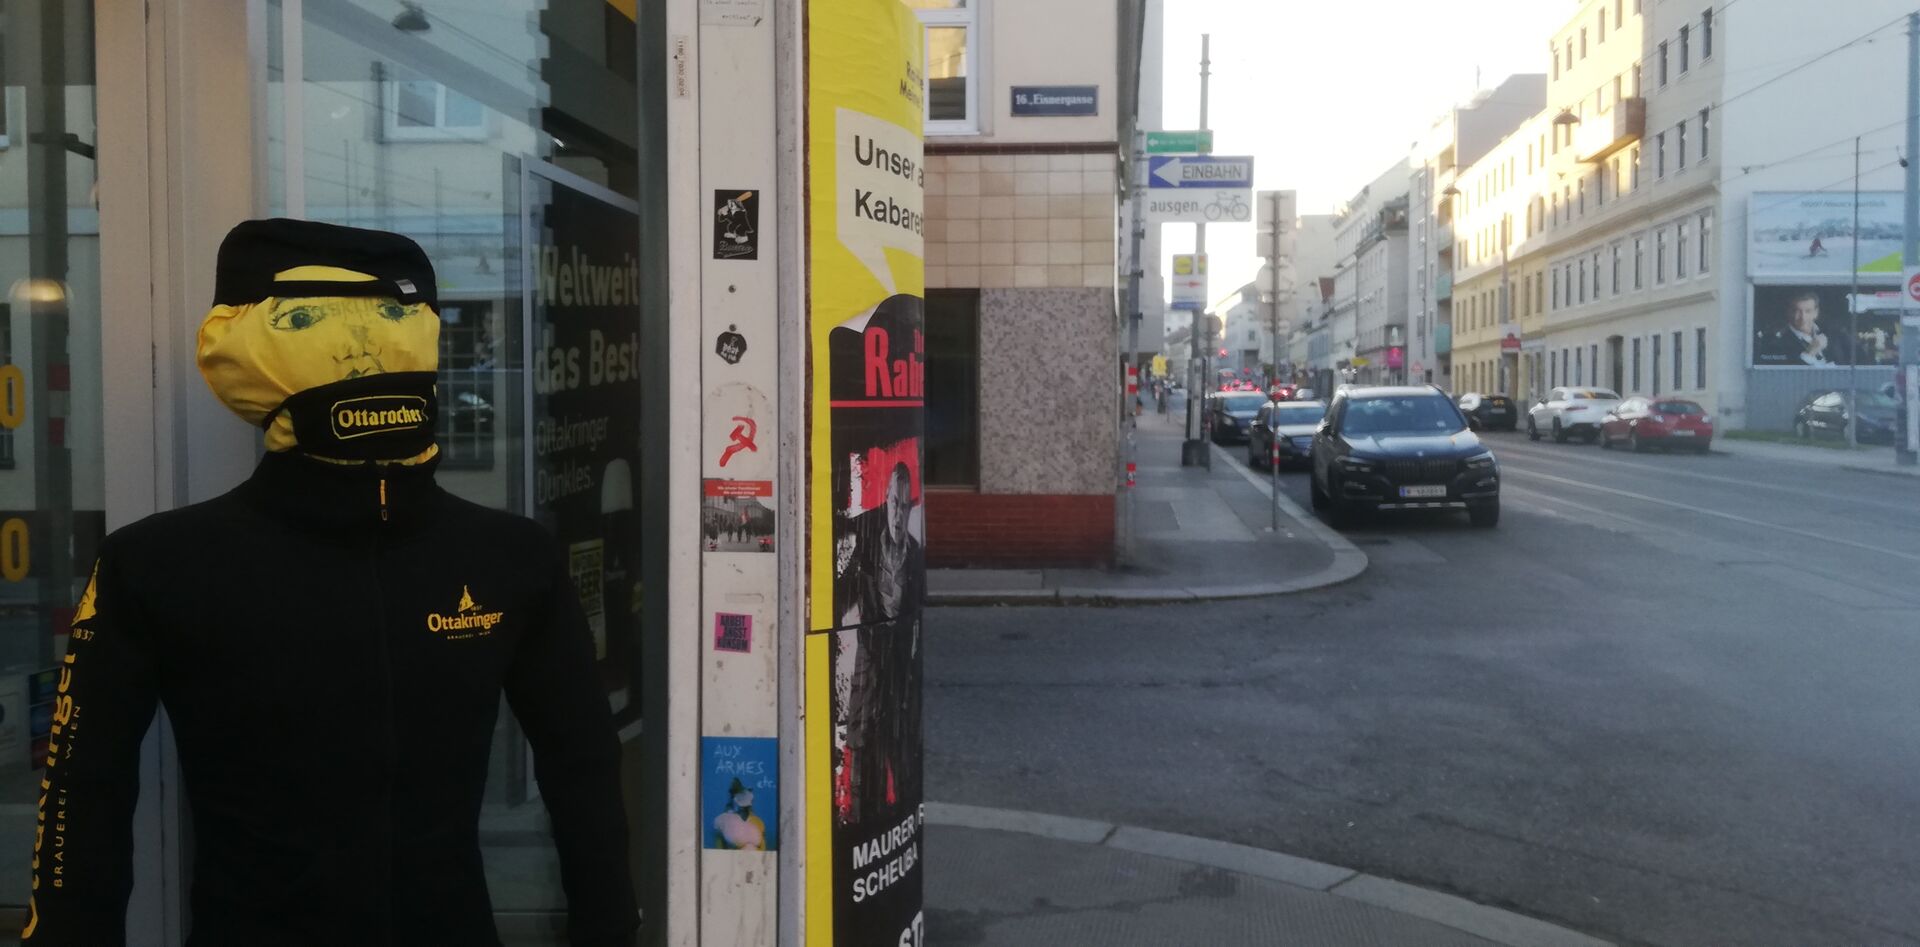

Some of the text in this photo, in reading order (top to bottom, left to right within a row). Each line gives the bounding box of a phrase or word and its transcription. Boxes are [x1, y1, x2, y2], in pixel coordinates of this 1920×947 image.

[854, 134, 915, 181] Unser
[1182, 164, 1242, 180] EINBAHN
[529, 244, 639, 308] Weltweit
[534, 328, 640, 395] das Best
[536, 414, 609, 457] Ottakringer
[71, 628, 95, 642] 1837
[427, 611, 505, 632] Ottakringer
[713, 744, 743, 759] AUX
[714, 759, 766, 776] ARMES
[52, 704, 82, 889] BRAUEREI WIEN
[852, 813, 915, 870] MAURER
